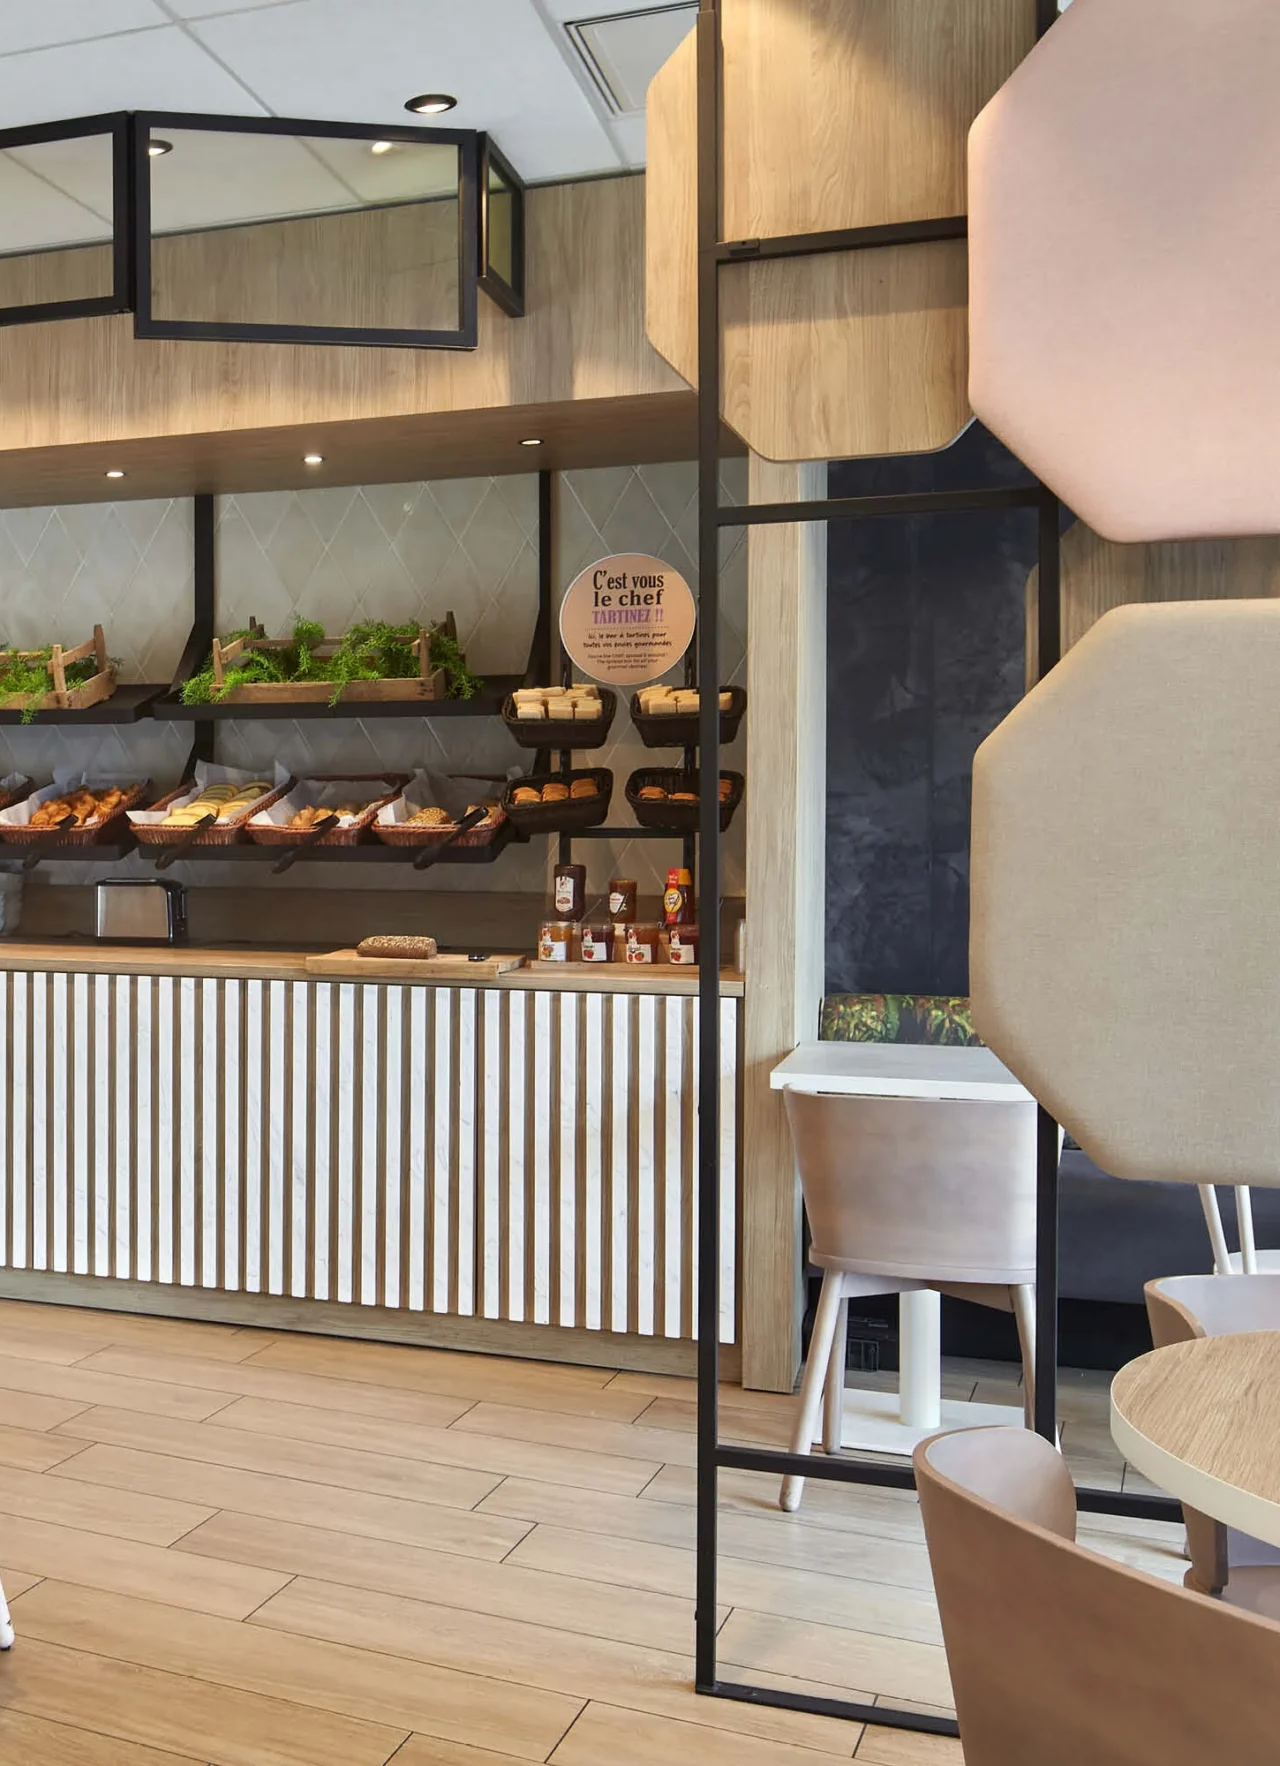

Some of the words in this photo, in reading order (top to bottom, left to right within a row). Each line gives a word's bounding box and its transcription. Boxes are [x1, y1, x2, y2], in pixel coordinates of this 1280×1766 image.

[593, 570, 627, 590] C'est
[632, 574, 664, 589] vous
[594, 591, 612, 607] le
[618, 589, 664, 606] chef
[592, 608, 651, 624] TARTINEZ
